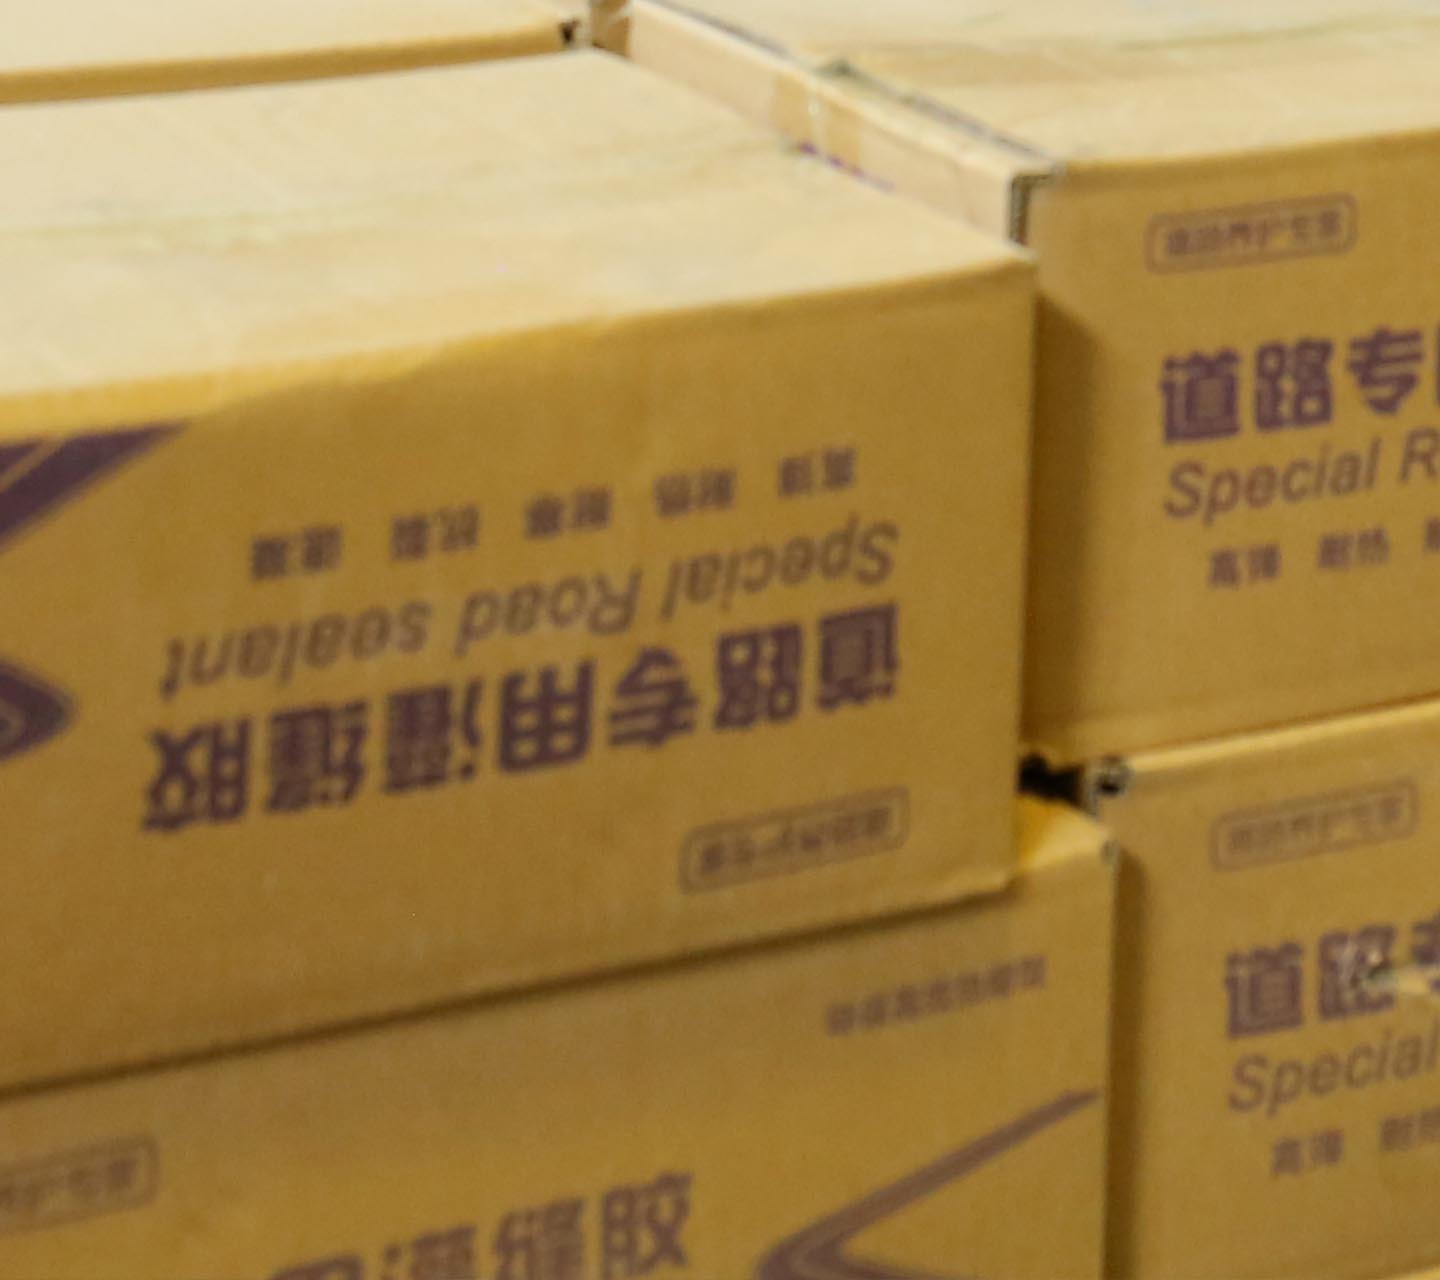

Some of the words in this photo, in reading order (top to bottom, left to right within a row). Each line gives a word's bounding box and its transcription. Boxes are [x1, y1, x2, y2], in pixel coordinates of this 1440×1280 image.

[1164, 436, 1379, 529] Special
[454, 567, 643, 652] Road
[660, 519, 900, 623] Special
[160, 594, 433, 692] sealant
[141, 600, 904, 835] 道路专用灌缝胶
[1229, 1014, 1440, 1118] Special
